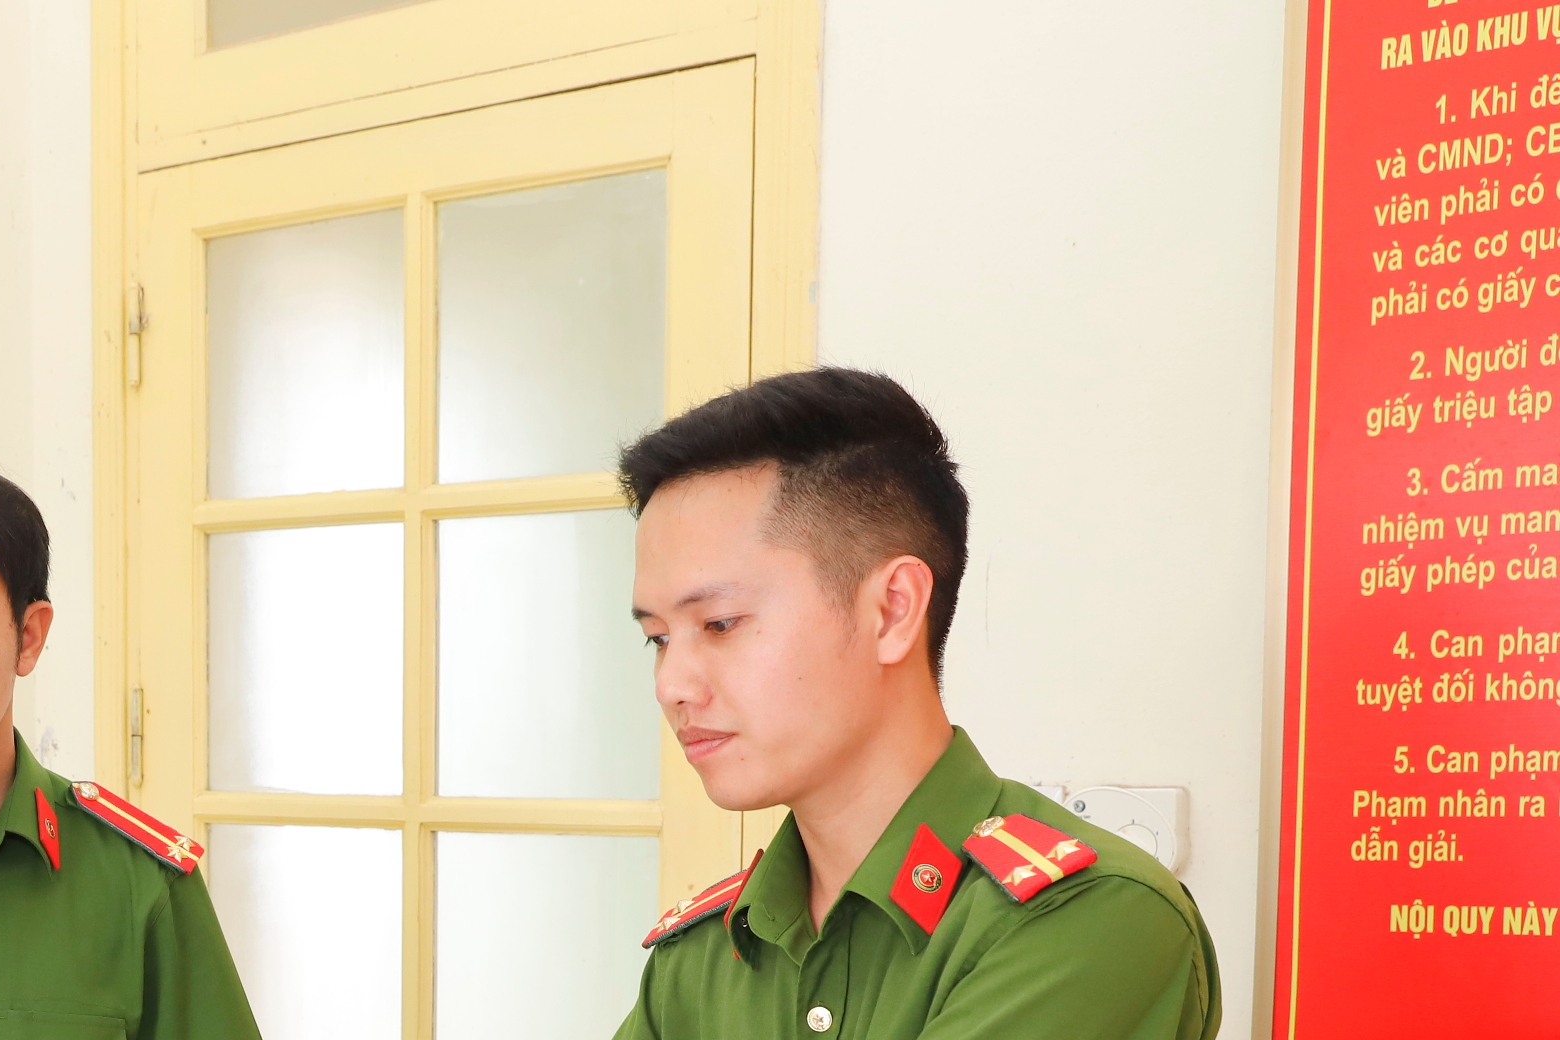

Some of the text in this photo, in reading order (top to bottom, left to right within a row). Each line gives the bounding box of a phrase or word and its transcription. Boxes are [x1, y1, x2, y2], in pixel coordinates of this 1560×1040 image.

[1381, 34, 1413, 70] RA
[1422, 20, 1468, 62] VÀO
[1477, 11, 1528, 52] KHU
[1436, 94, 1456, 124] 1.
[1471, 82, 1517, 119] Khi
[1376, 148, 1406, 180] và
[1417, 133, 1512, 173] CMND;
[1374, 193, 1429, 226] viên
[1440, 178, 1499, 225] phải
[1510, 173, 1545, 207] có
[1372, 241, 1402, 272] và
[1415, 235, 1462, 267] các
[1474, 230, 1508, 259] cơ
[1371, 281, 1427, 326] phải
[1436, 277, 1469, 310] có
[1477, 266, 1536, 313] giấy
[1409, 350, 1432, 380] 2.
[1445, 339, 1527, 382] Người
[1366, 384, 1552, 437] giấy triệu tập
[1406, 467, 1428, 497] 3.
[1441, 457, 1503, 493] Cấm
[1362, 512, 1444, 549] nhiệm
[1456, 515, 1489, 545] vụ
[1360, 543, 1557, 597] giấy phép của
[1393, 631, 1415, 659] 4.
[1430, 629, 1483, 658] Can
[1356, 668, 1560, 712] tuyệt đối khôn
[1394, 744, 1560, 780] 5. Can phạm
[1353, 788, 1545, 825] Phạm nhân ra
[1350, 826, 1464, 869] dẫn giải.
[1389, 899, 1558, 939] NỘI QUY NÀY
